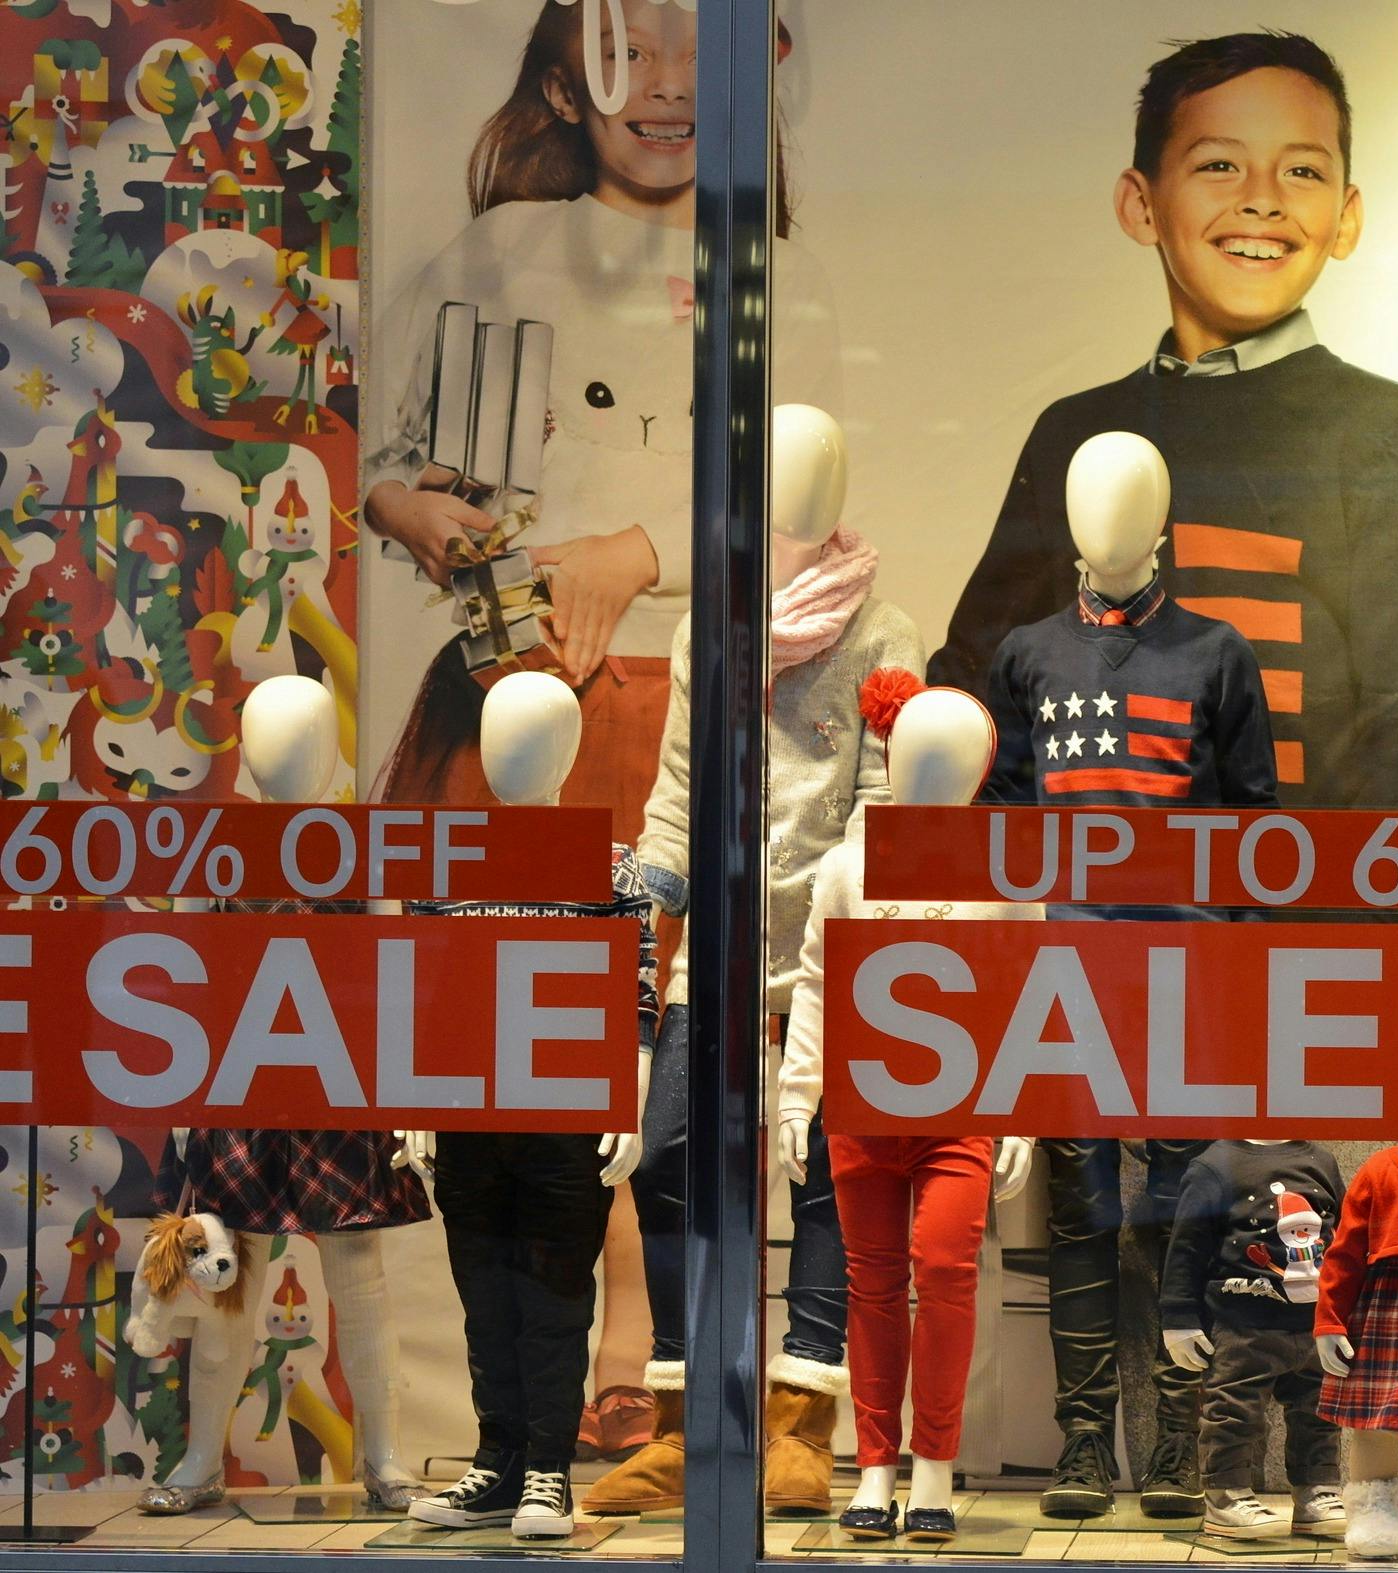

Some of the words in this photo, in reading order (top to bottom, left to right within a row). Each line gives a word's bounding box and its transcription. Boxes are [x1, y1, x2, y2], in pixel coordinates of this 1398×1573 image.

[0, 805, 244, 897] 60%
[281, 808, 489, 898] OFF
[988, 812, 1136, 902] UP
[1167, 814, 1316, 905] TO
[81, 933, 610, 1111] SALE
[847, 941, 1384, 1119] SALE
